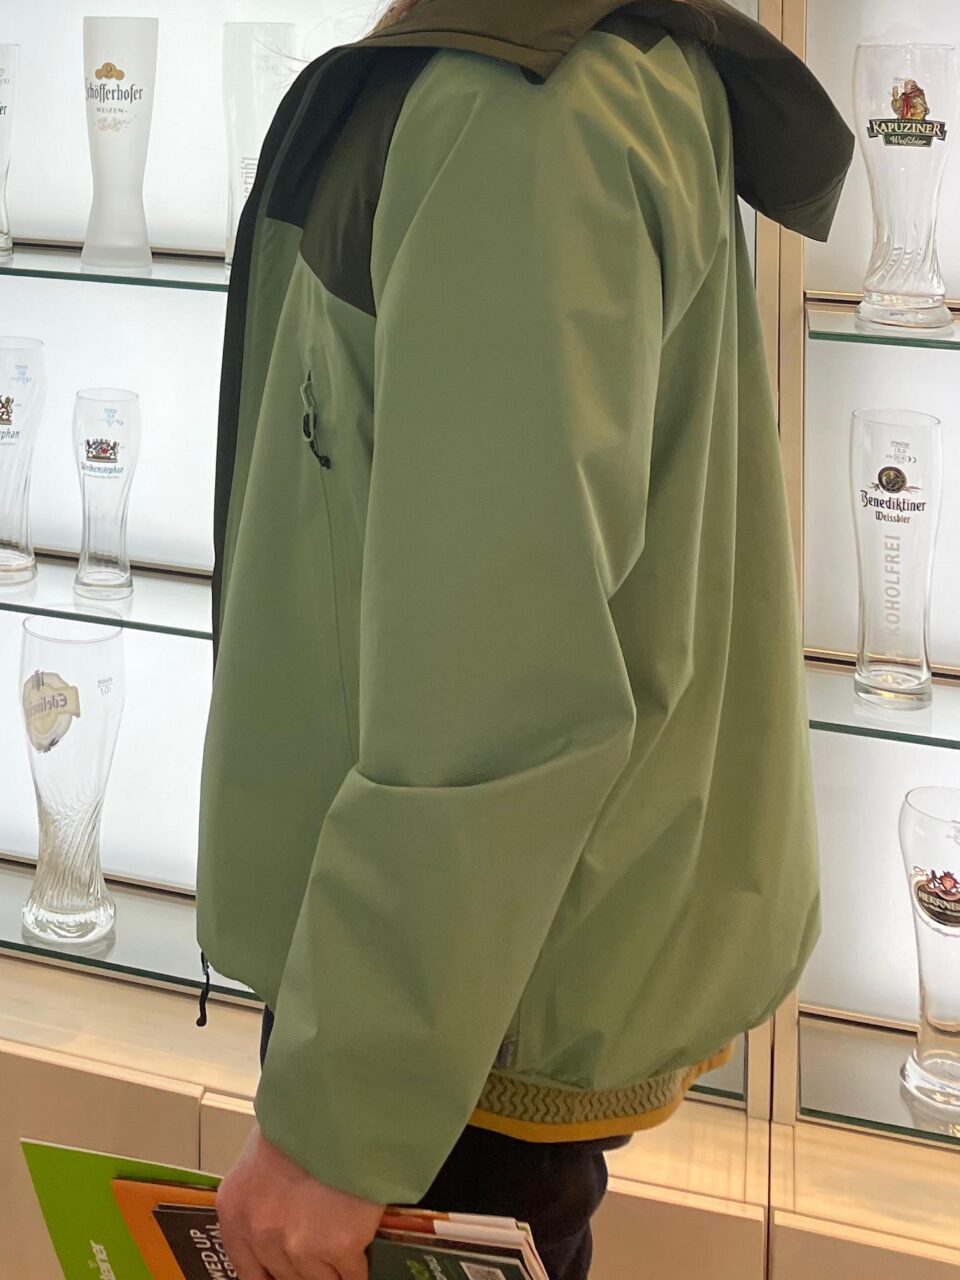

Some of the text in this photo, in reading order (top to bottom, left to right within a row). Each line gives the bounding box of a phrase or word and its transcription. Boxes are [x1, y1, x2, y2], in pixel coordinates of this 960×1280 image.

[872, 122, 941, 136] KAPUZINER
[860, 489, 927, 512] Benediktiner
[875, 511, 911, 524] Weissbier
[884, 535, 900, 637] KOHOLFREI
[190, 1229, 211, 1249] UP
